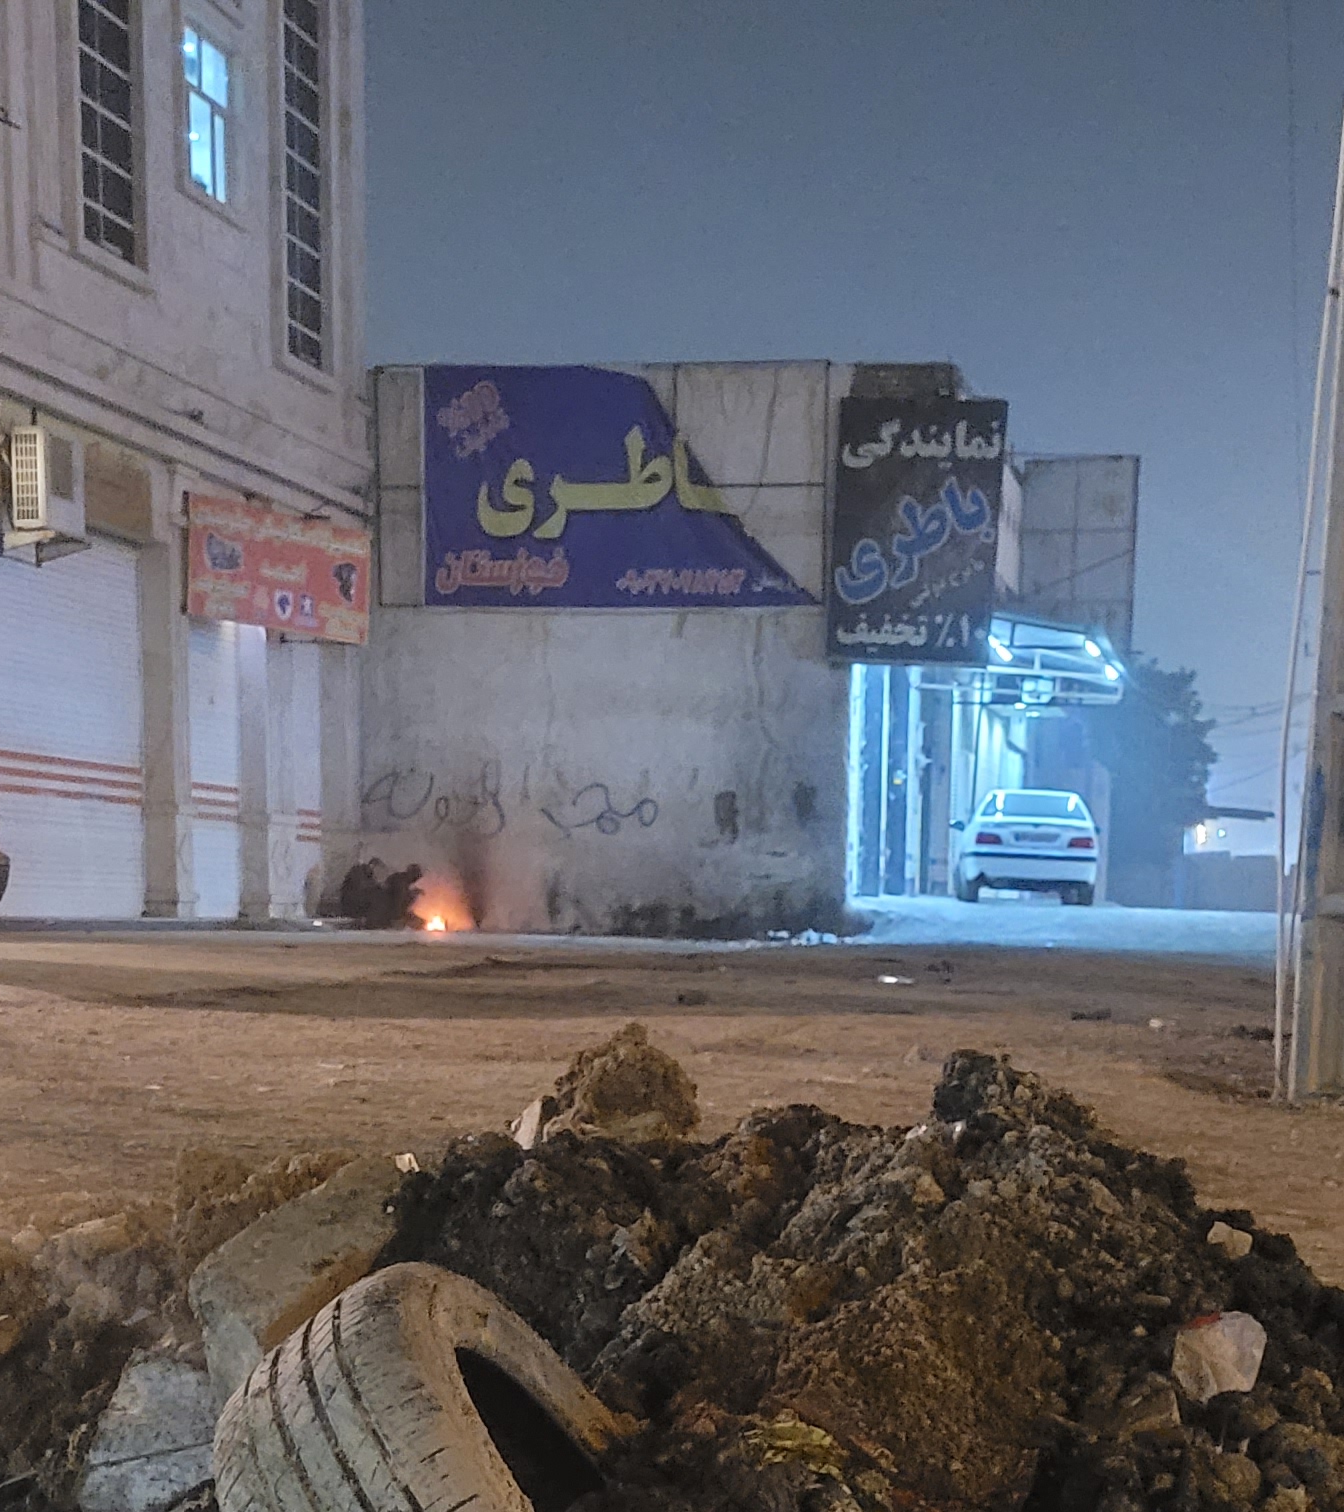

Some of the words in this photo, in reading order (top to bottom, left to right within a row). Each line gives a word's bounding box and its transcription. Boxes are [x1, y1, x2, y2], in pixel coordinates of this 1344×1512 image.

[842, 418, 1002, 468] نمایندگی
[834, 476, 996, 604] باطری
[836, 612, 928, 653] تخفیف
